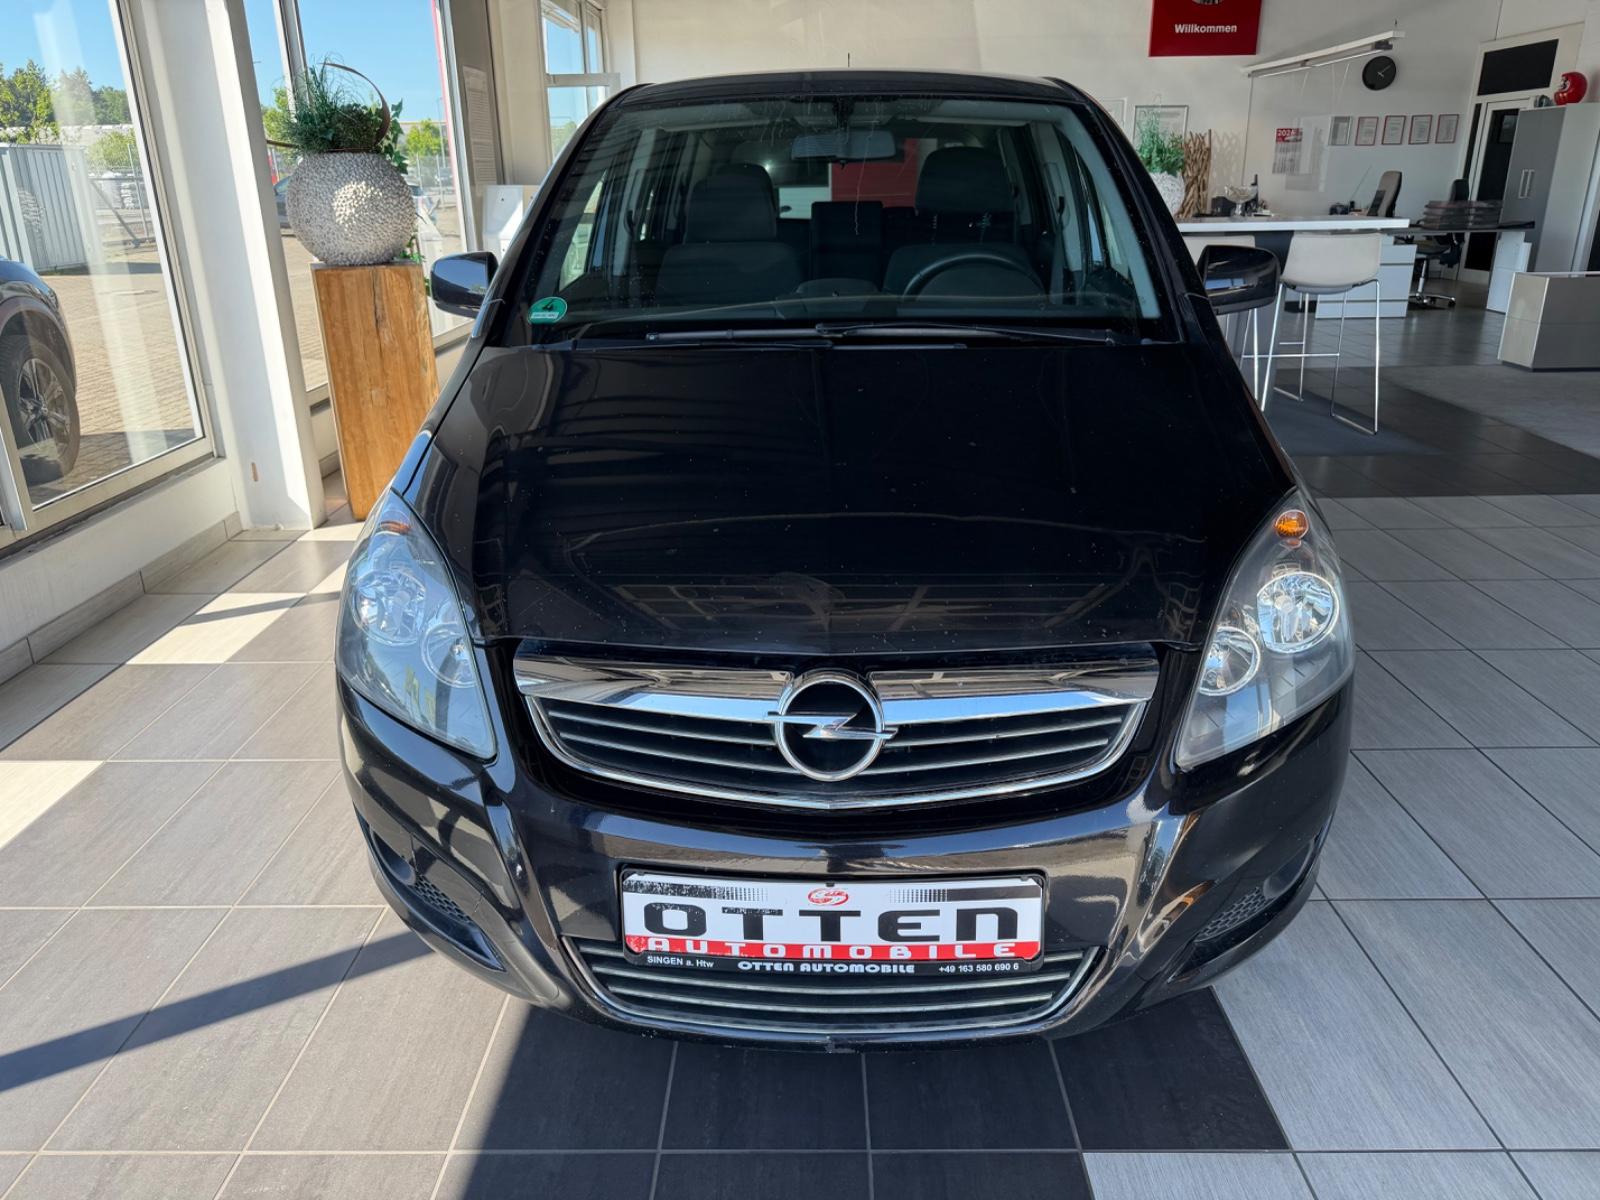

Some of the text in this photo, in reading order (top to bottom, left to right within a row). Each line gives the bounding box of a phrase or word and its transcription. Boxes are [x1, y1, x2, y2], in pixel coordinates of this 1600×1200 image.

[1174, 24, 1237, 33] Willkommen
[643, 902, 1018, 943] OTTEN
[647, 937, 1015, 960] AUTOMOBILE
[647, 955, 684, 966] SINGEN
[696, 959, 715, 968] Htw
[737, 960, 915, 974] OTTEN AUTOMOBILE
[938, 962, 1019, 973] +49 163 580 690 6
